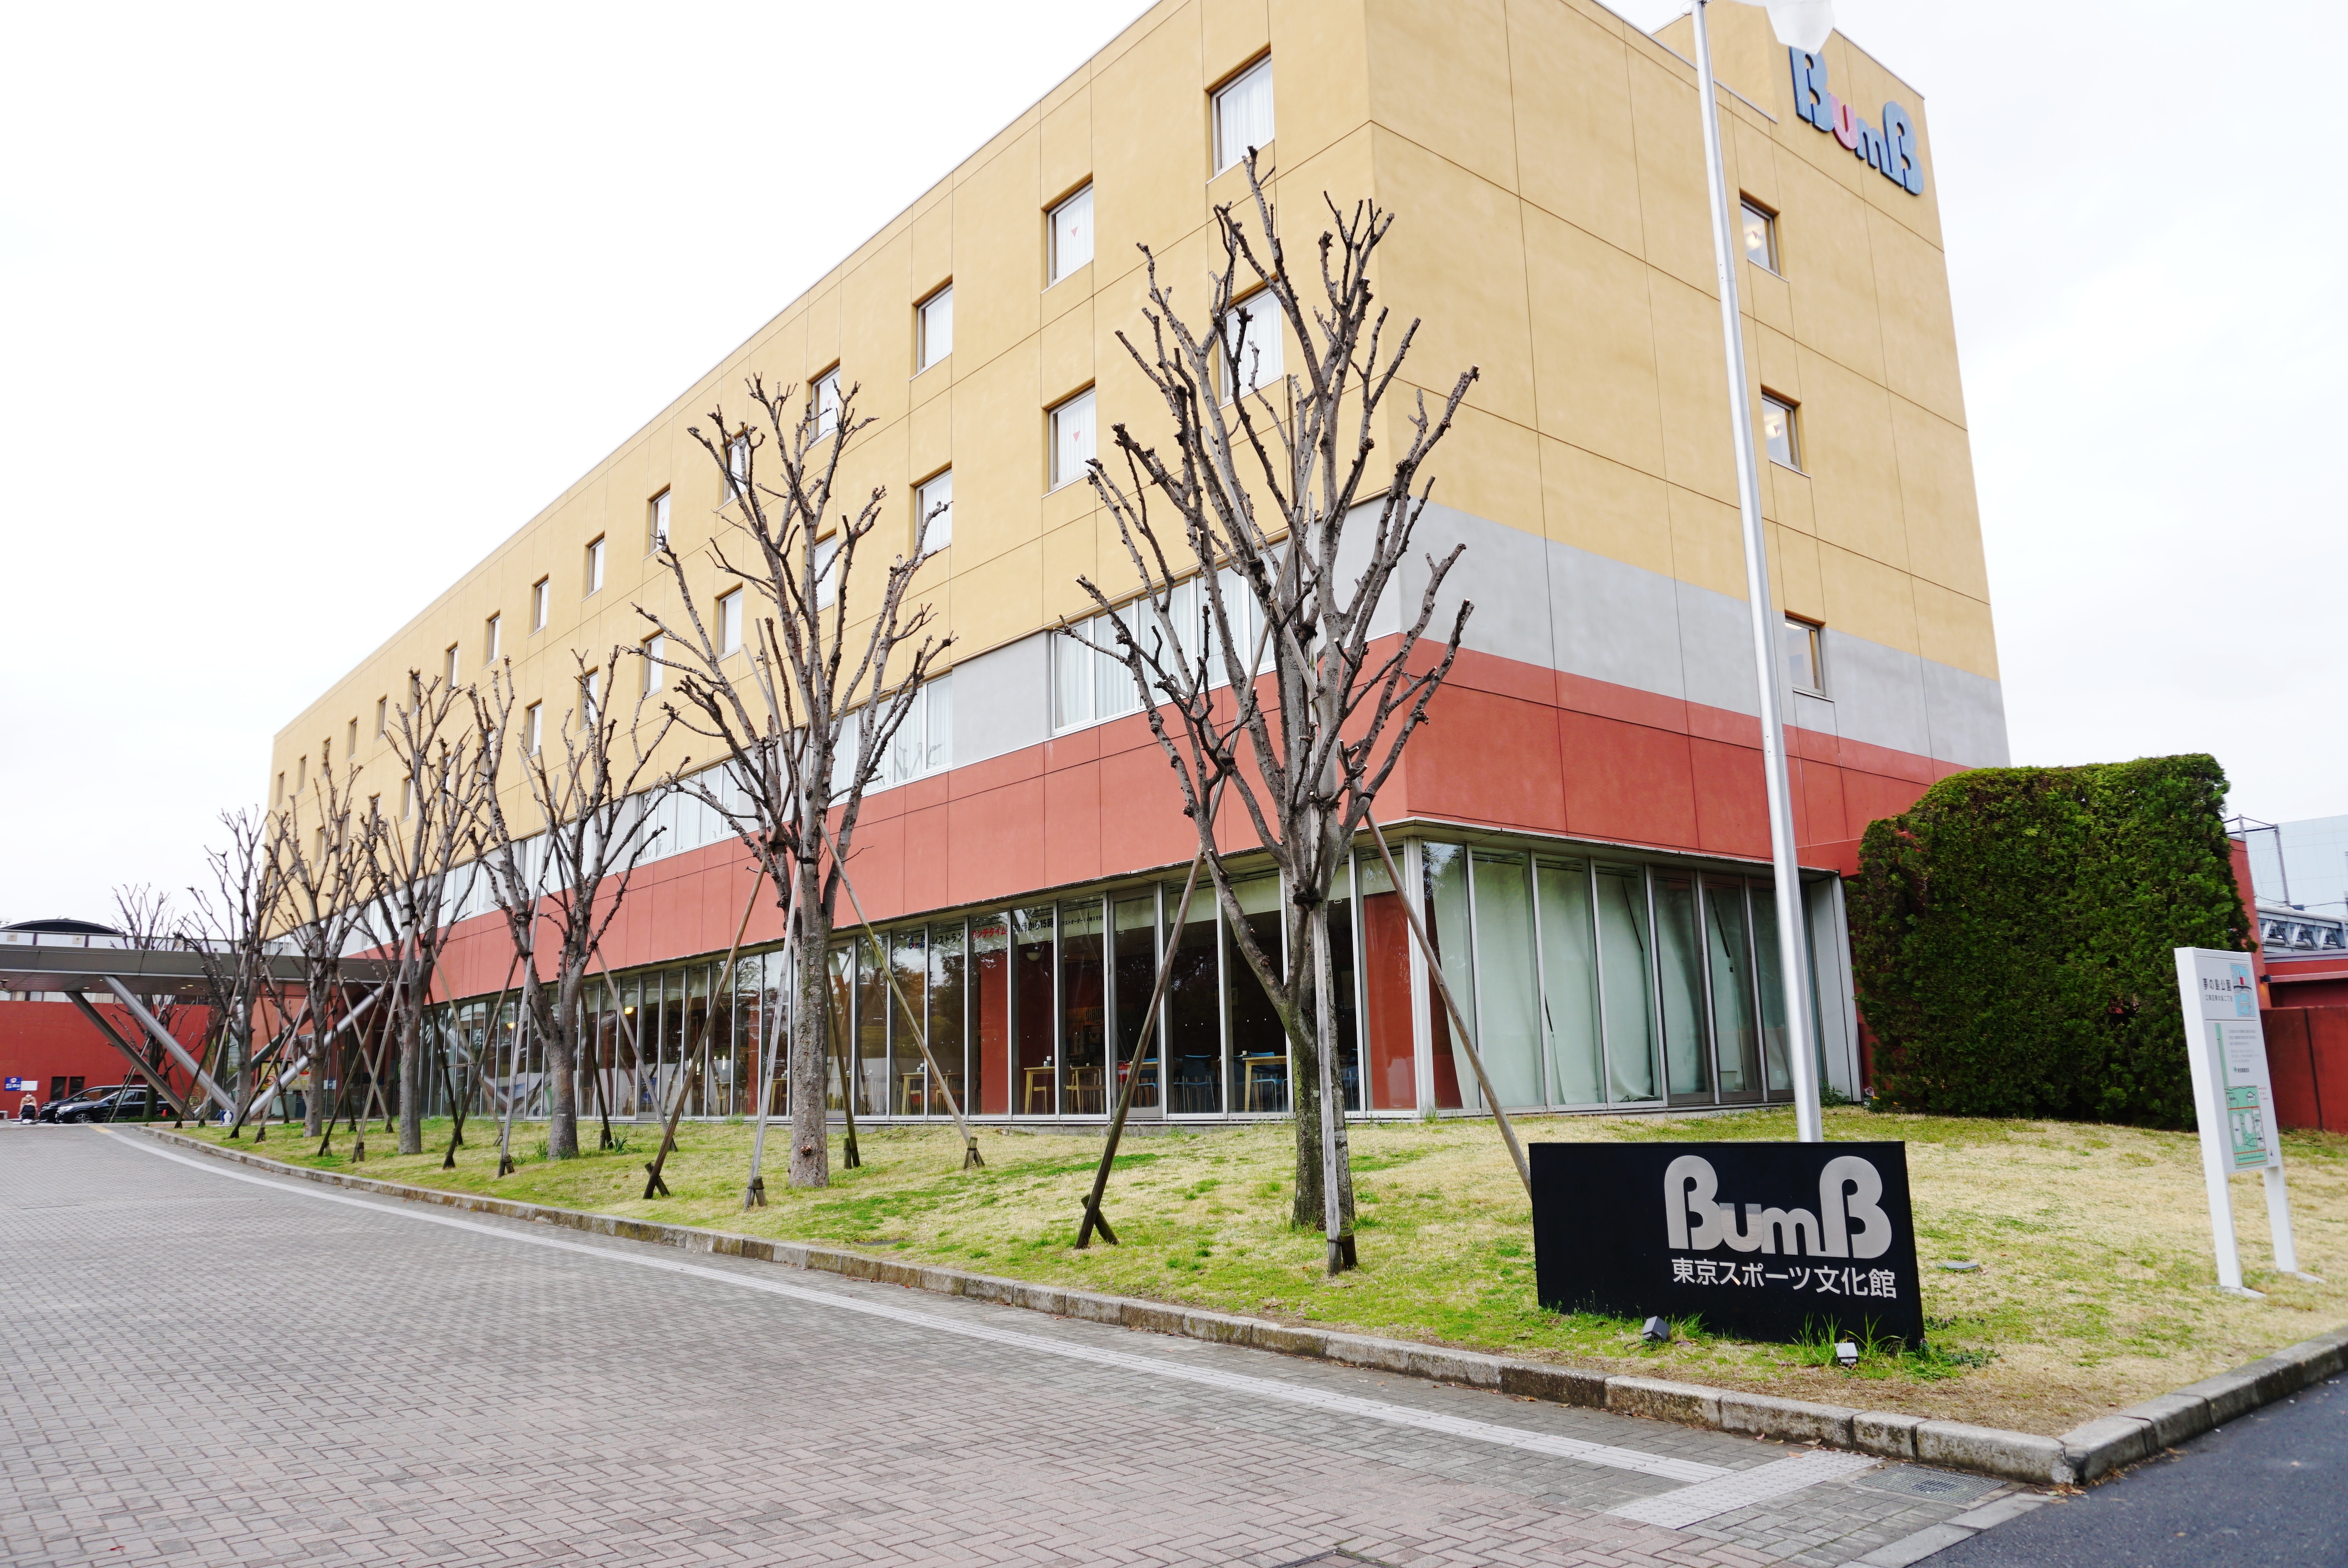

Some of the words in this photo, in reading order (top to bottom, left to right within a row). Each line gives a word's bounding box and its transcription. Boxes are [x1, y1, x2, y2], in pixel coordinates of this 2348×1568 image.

[1671, 1258, 1897, 1299] 東京スポーツ文化館
